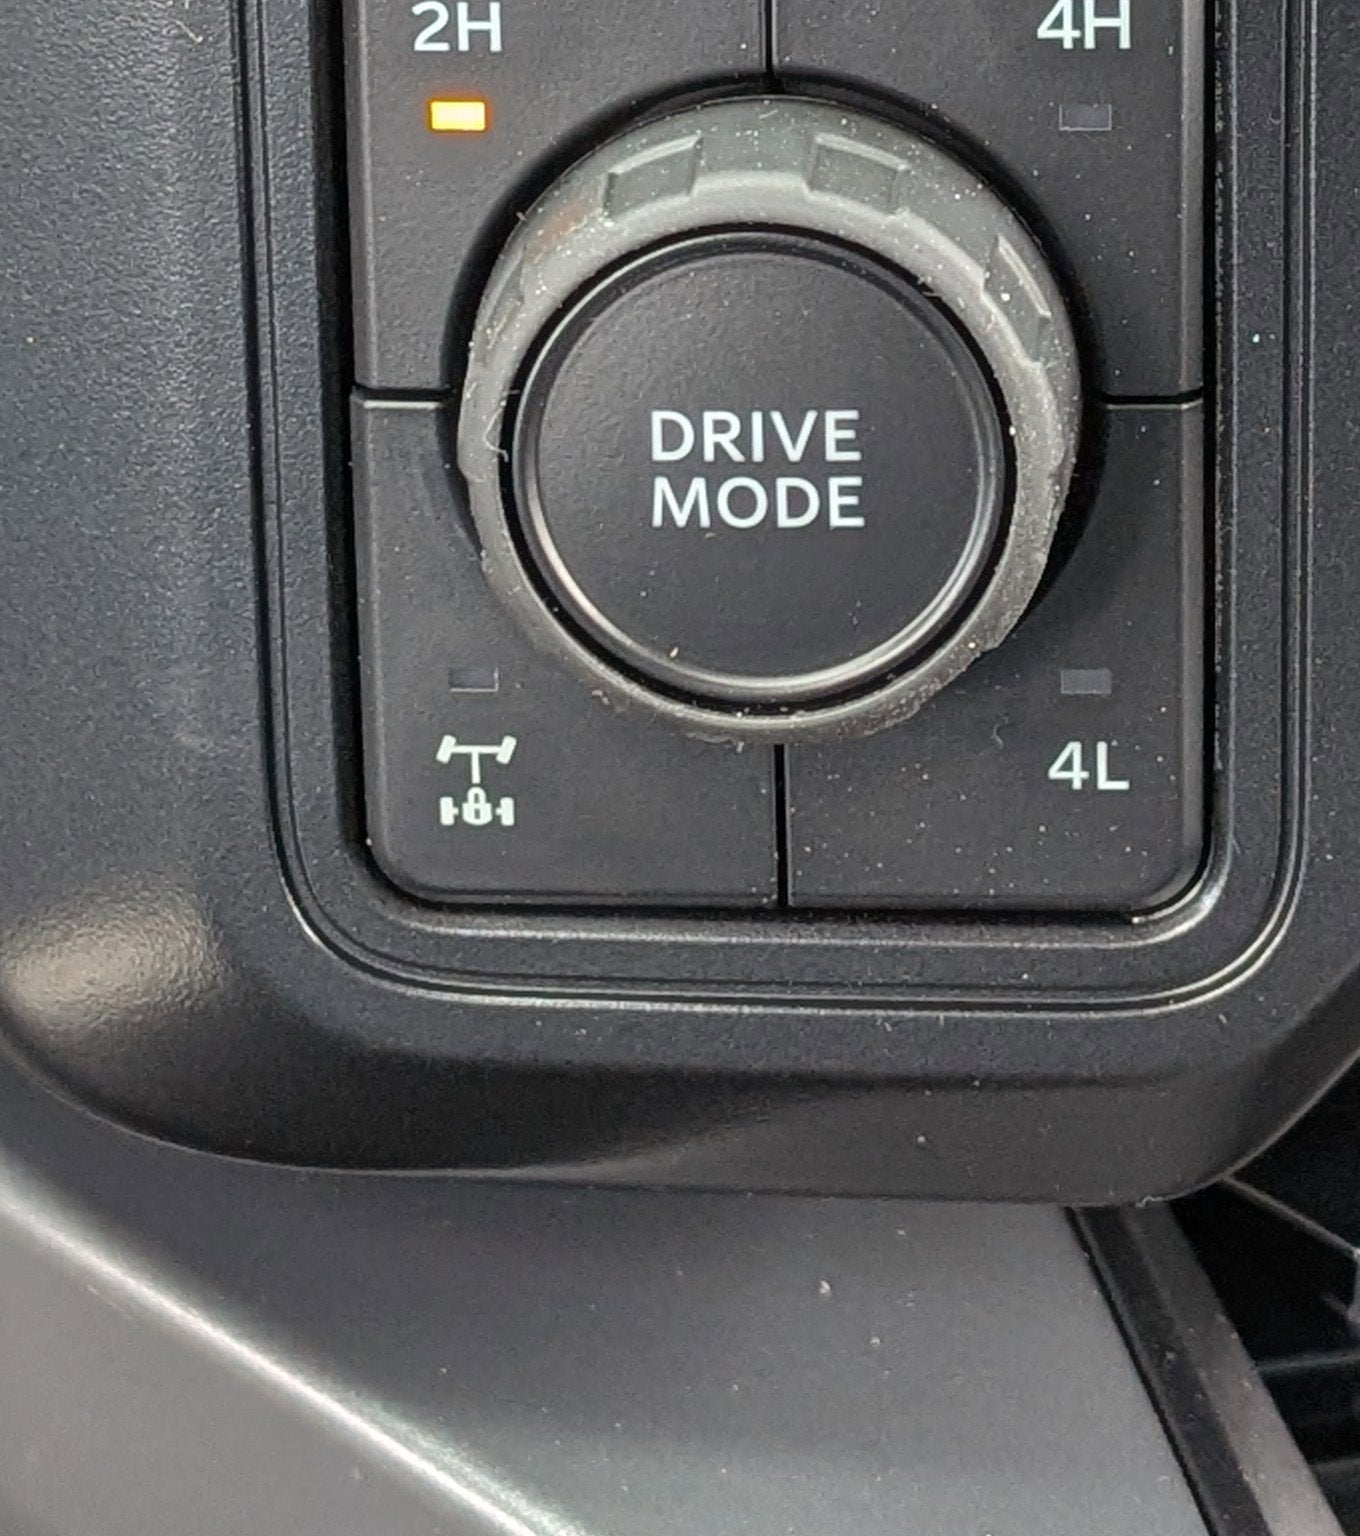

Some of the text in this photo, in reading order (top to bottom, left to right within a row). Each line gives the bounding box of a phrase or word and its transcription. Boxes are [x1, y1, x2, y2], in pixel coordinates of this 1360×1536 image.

[410, 0, 503, 54] 2H
[649, 408, 862, 463] DRIVE
[651, 475, 866, 529] MODE
[1047, 740, 1131, 791] 4L
